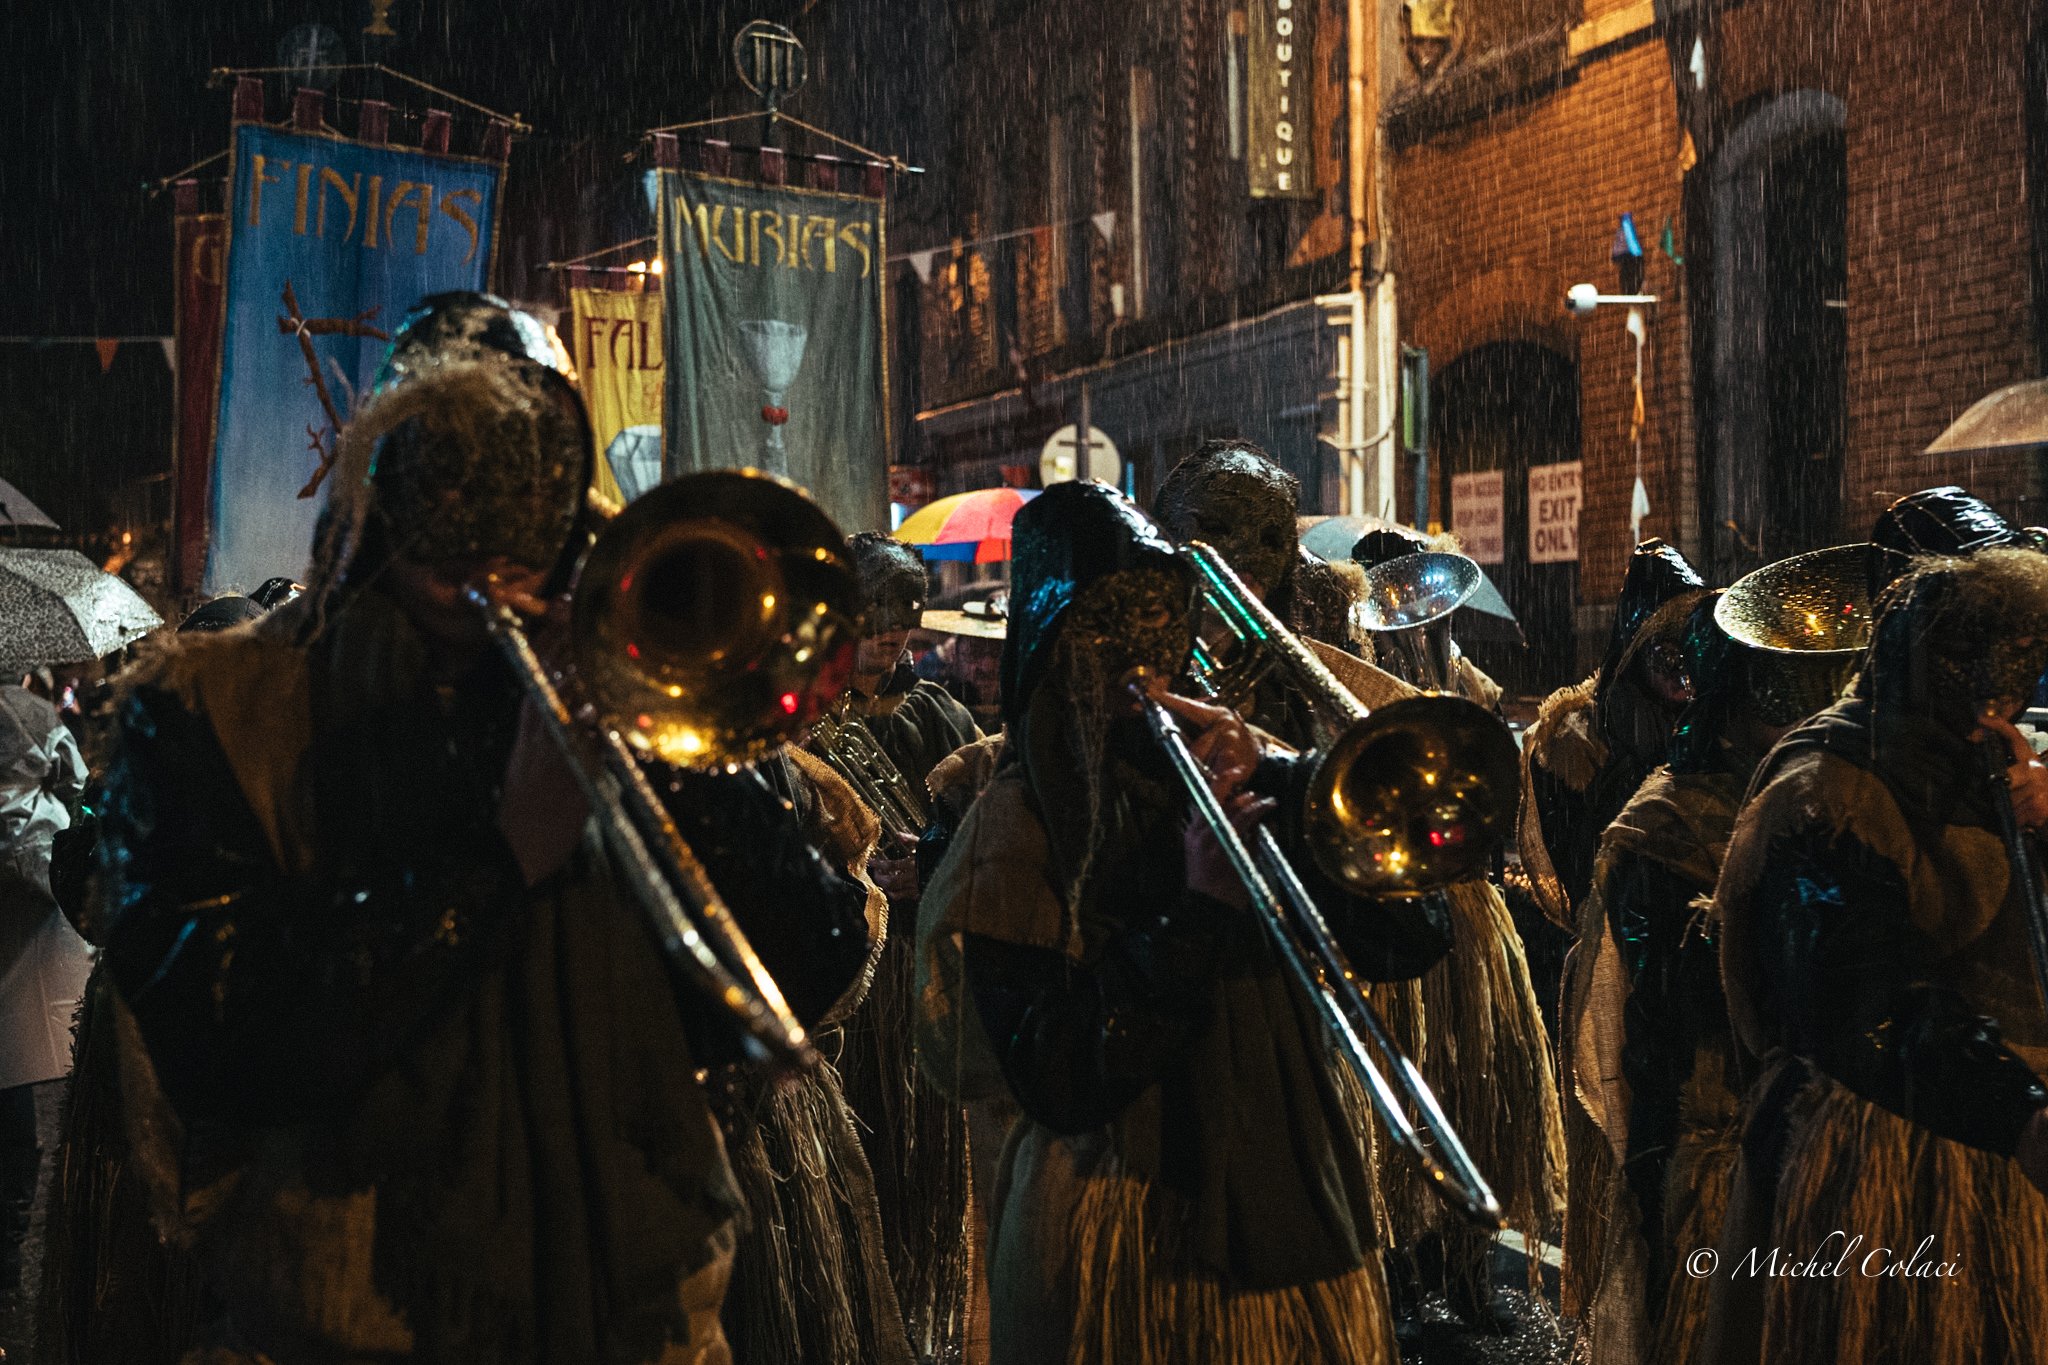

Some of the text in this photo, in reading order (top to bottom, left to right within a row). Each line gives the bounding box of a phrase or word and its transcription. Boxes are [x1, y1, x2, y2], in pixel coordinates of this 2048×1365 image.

[248, 154, 483, 269] FINIAS
[675, 195, 872, 279] MURIAS
[584, 317, 664, 370] FAL
[1539, 497, 1577, 524] EXIT
[1534, 526, 1577, 553] ONLY
